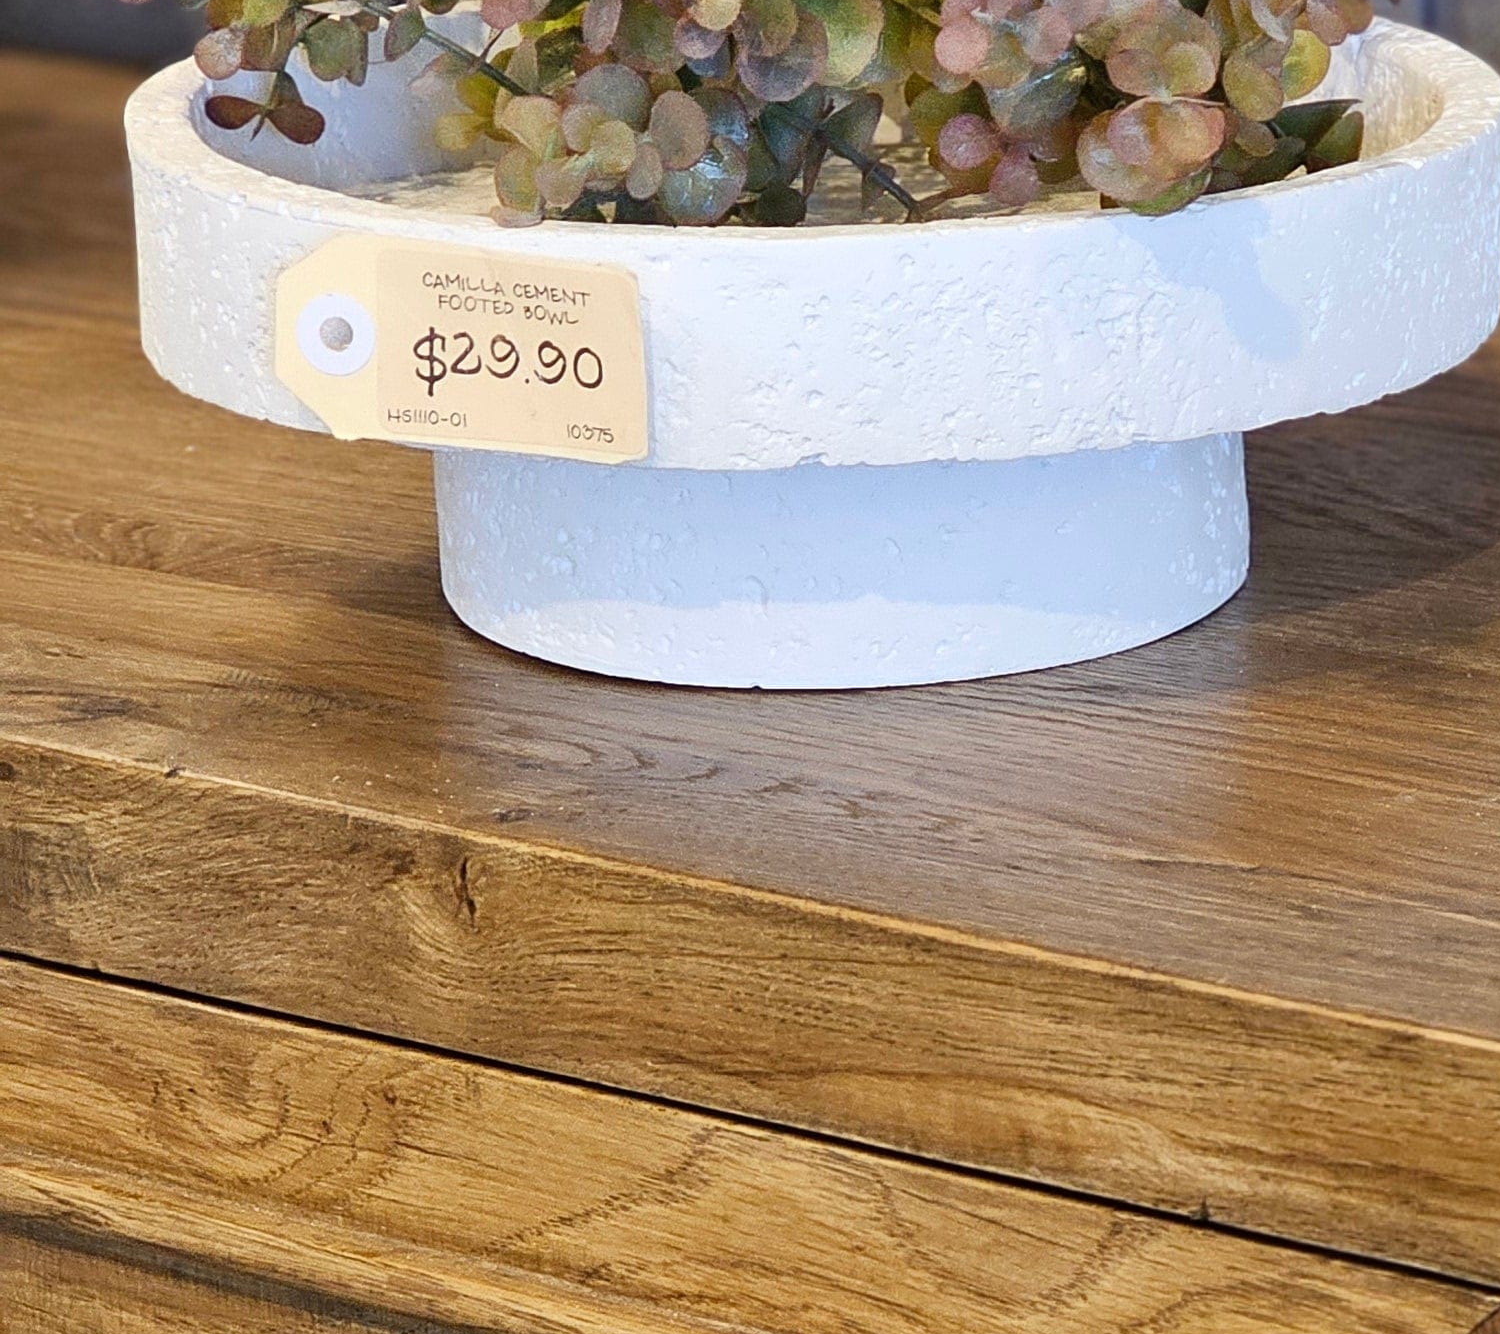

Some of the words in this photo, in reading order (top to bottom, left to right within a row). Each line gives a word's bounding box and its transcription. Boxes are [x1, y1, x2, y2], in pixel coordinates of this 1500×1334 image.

[422, 271, 505, 297] CAMILLA
[513, 283, 591, 308] CEMENT
[438, 294, 514, 316] FOOTED
[523, 304, 579, 325] BOWL
[413, 326, 604, 397] $29.90
[566, 423, 615, 443] 10375
